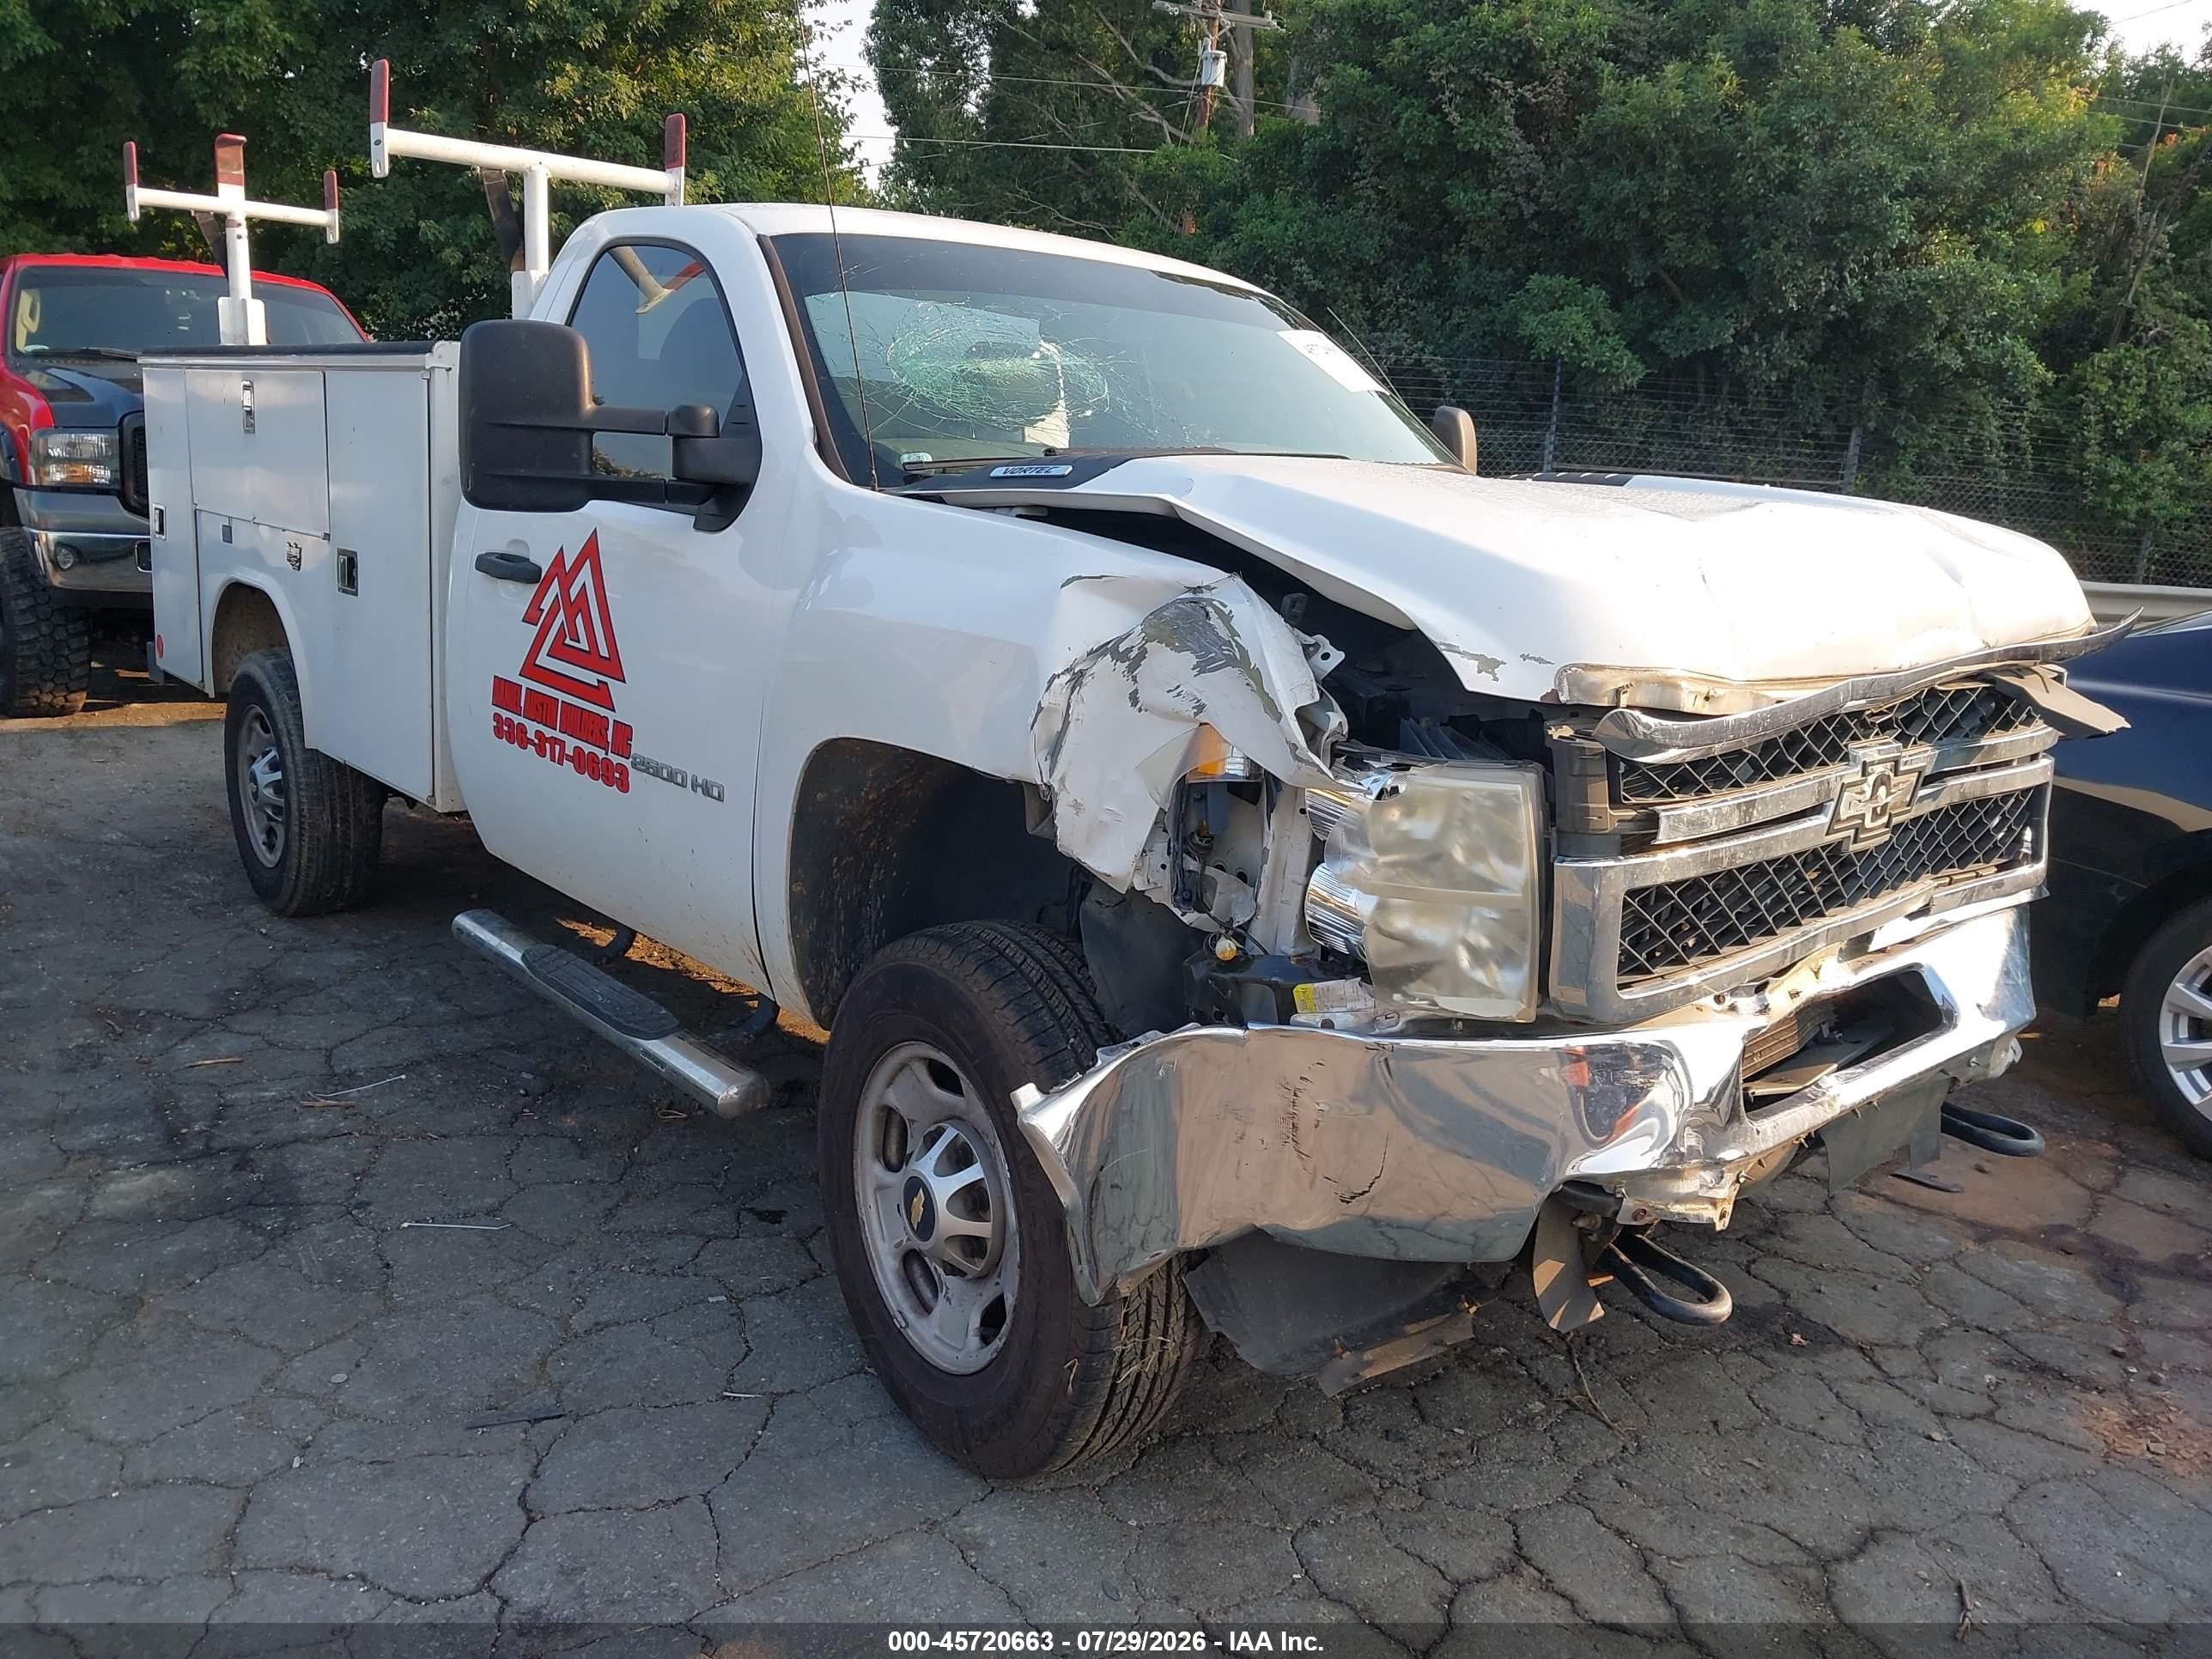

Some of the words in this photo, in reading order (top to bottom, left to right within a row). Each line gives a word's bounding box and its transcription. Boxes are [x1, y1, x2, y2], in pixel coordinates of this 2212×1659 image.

[1002, 466, 1061, 475] VORTEC
[523, 687, 559, 732] AUSTIN
[492, 712, 630, 794] 336-317-0693
[630, 752, 688, 788] 2500
[690, 774, 725, 803] HD
